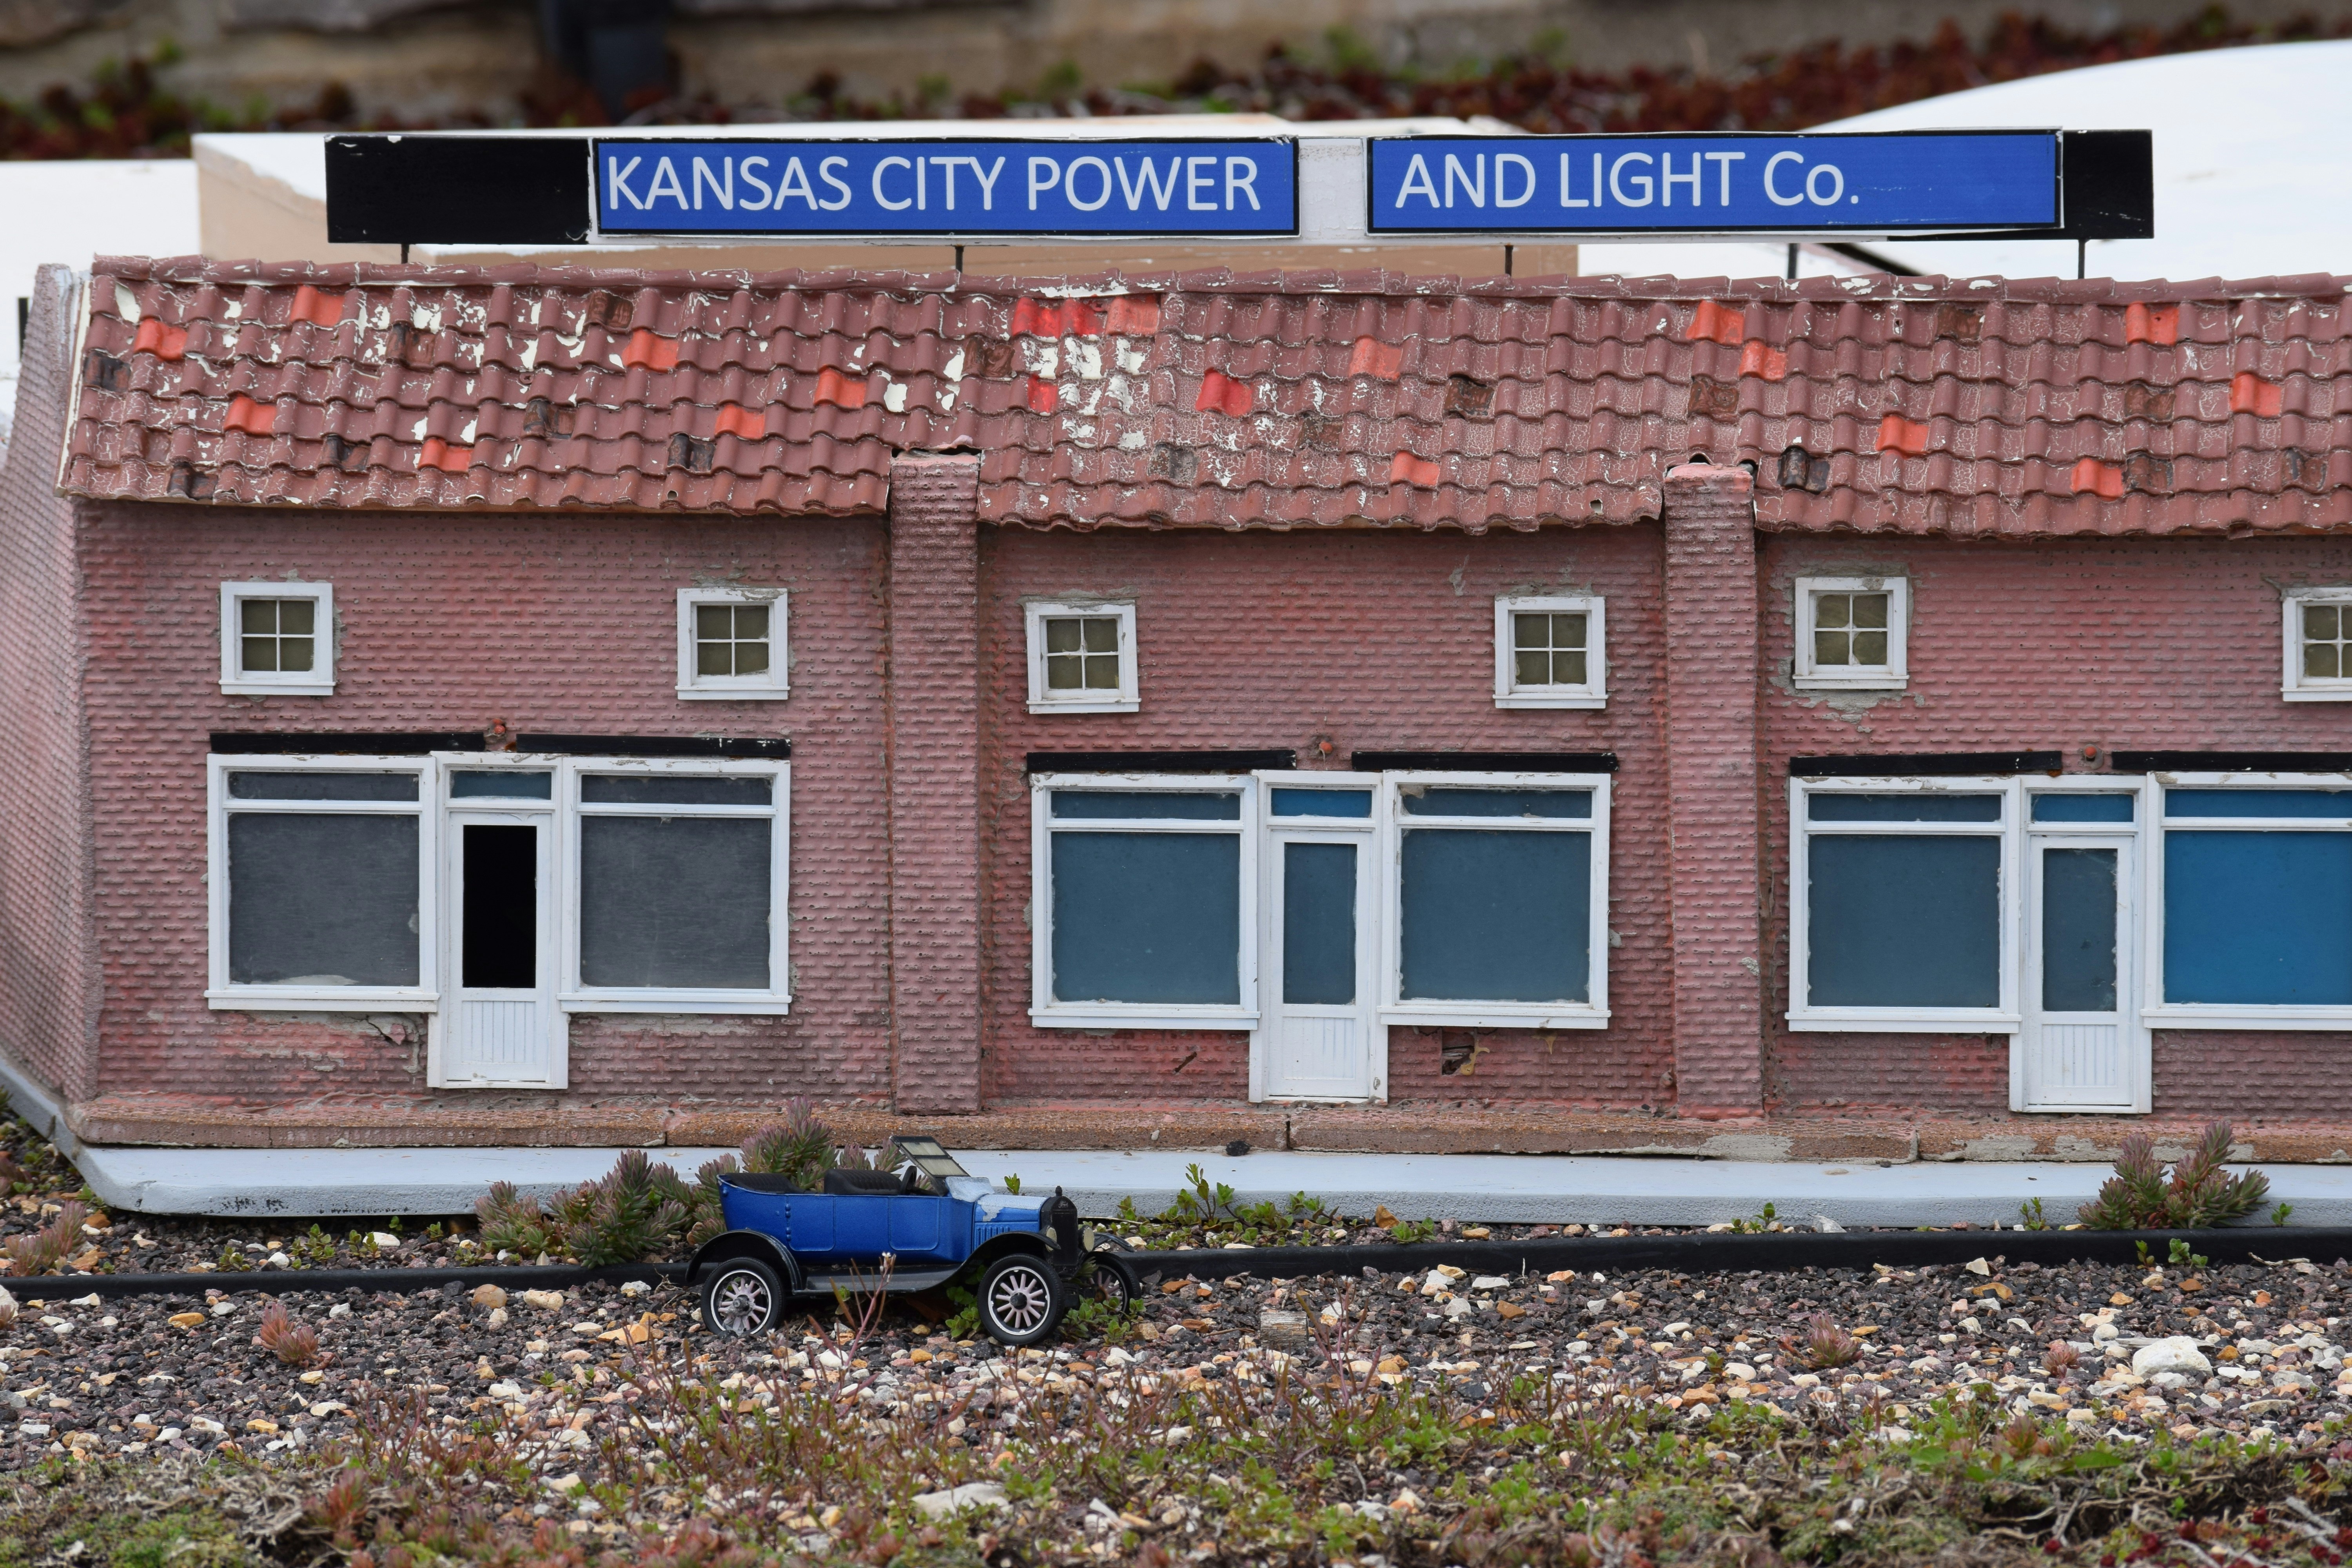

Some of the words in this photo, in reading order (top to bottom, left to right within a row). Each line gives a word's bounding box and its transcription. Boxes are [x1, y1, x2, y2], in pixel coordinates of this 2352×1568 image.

[608, 156, 852, 211] KANSAS
[872, 156, 1006, 211] CITY
[1028, 156, 1261, 211] POWER
[1395, 153, 1536, 209] AND
[1560, 151, 1746, 208] LIGHT
[1764, 151, 1859, 206] Co.
